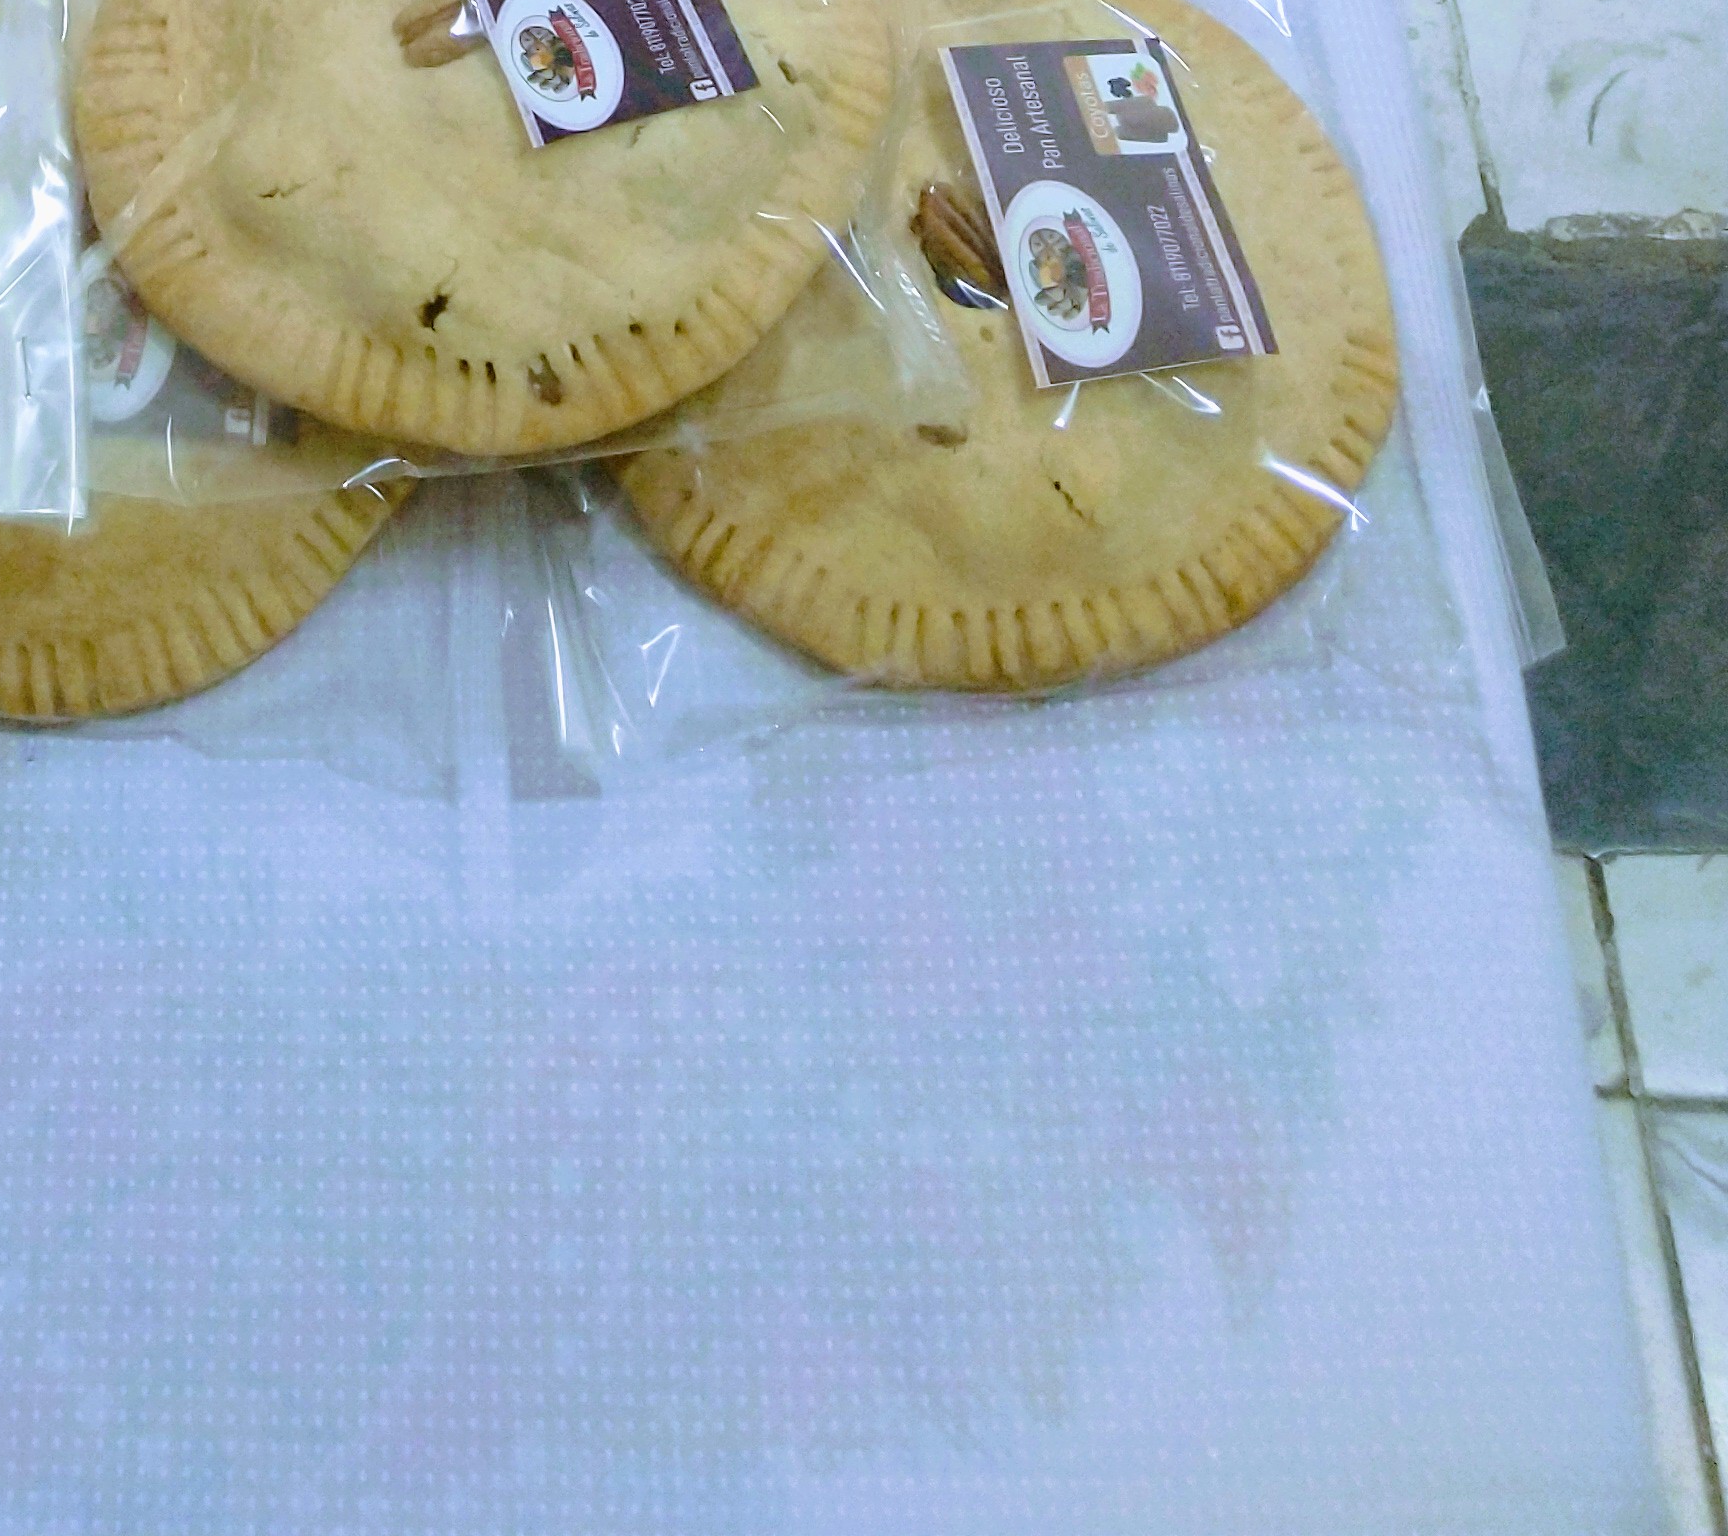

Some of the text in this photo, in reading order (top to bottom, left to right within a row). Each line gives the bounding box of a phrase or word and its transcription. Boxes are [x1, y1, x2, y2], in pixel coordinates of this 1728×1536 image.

[983, 77, 1024, 154] Delicioso
[1008, 56, 1065, 169] Pan Artesanal
[1075, 72, 1110, 139] Coyotas
[1147, 205, 1193, 282] 8119077022
